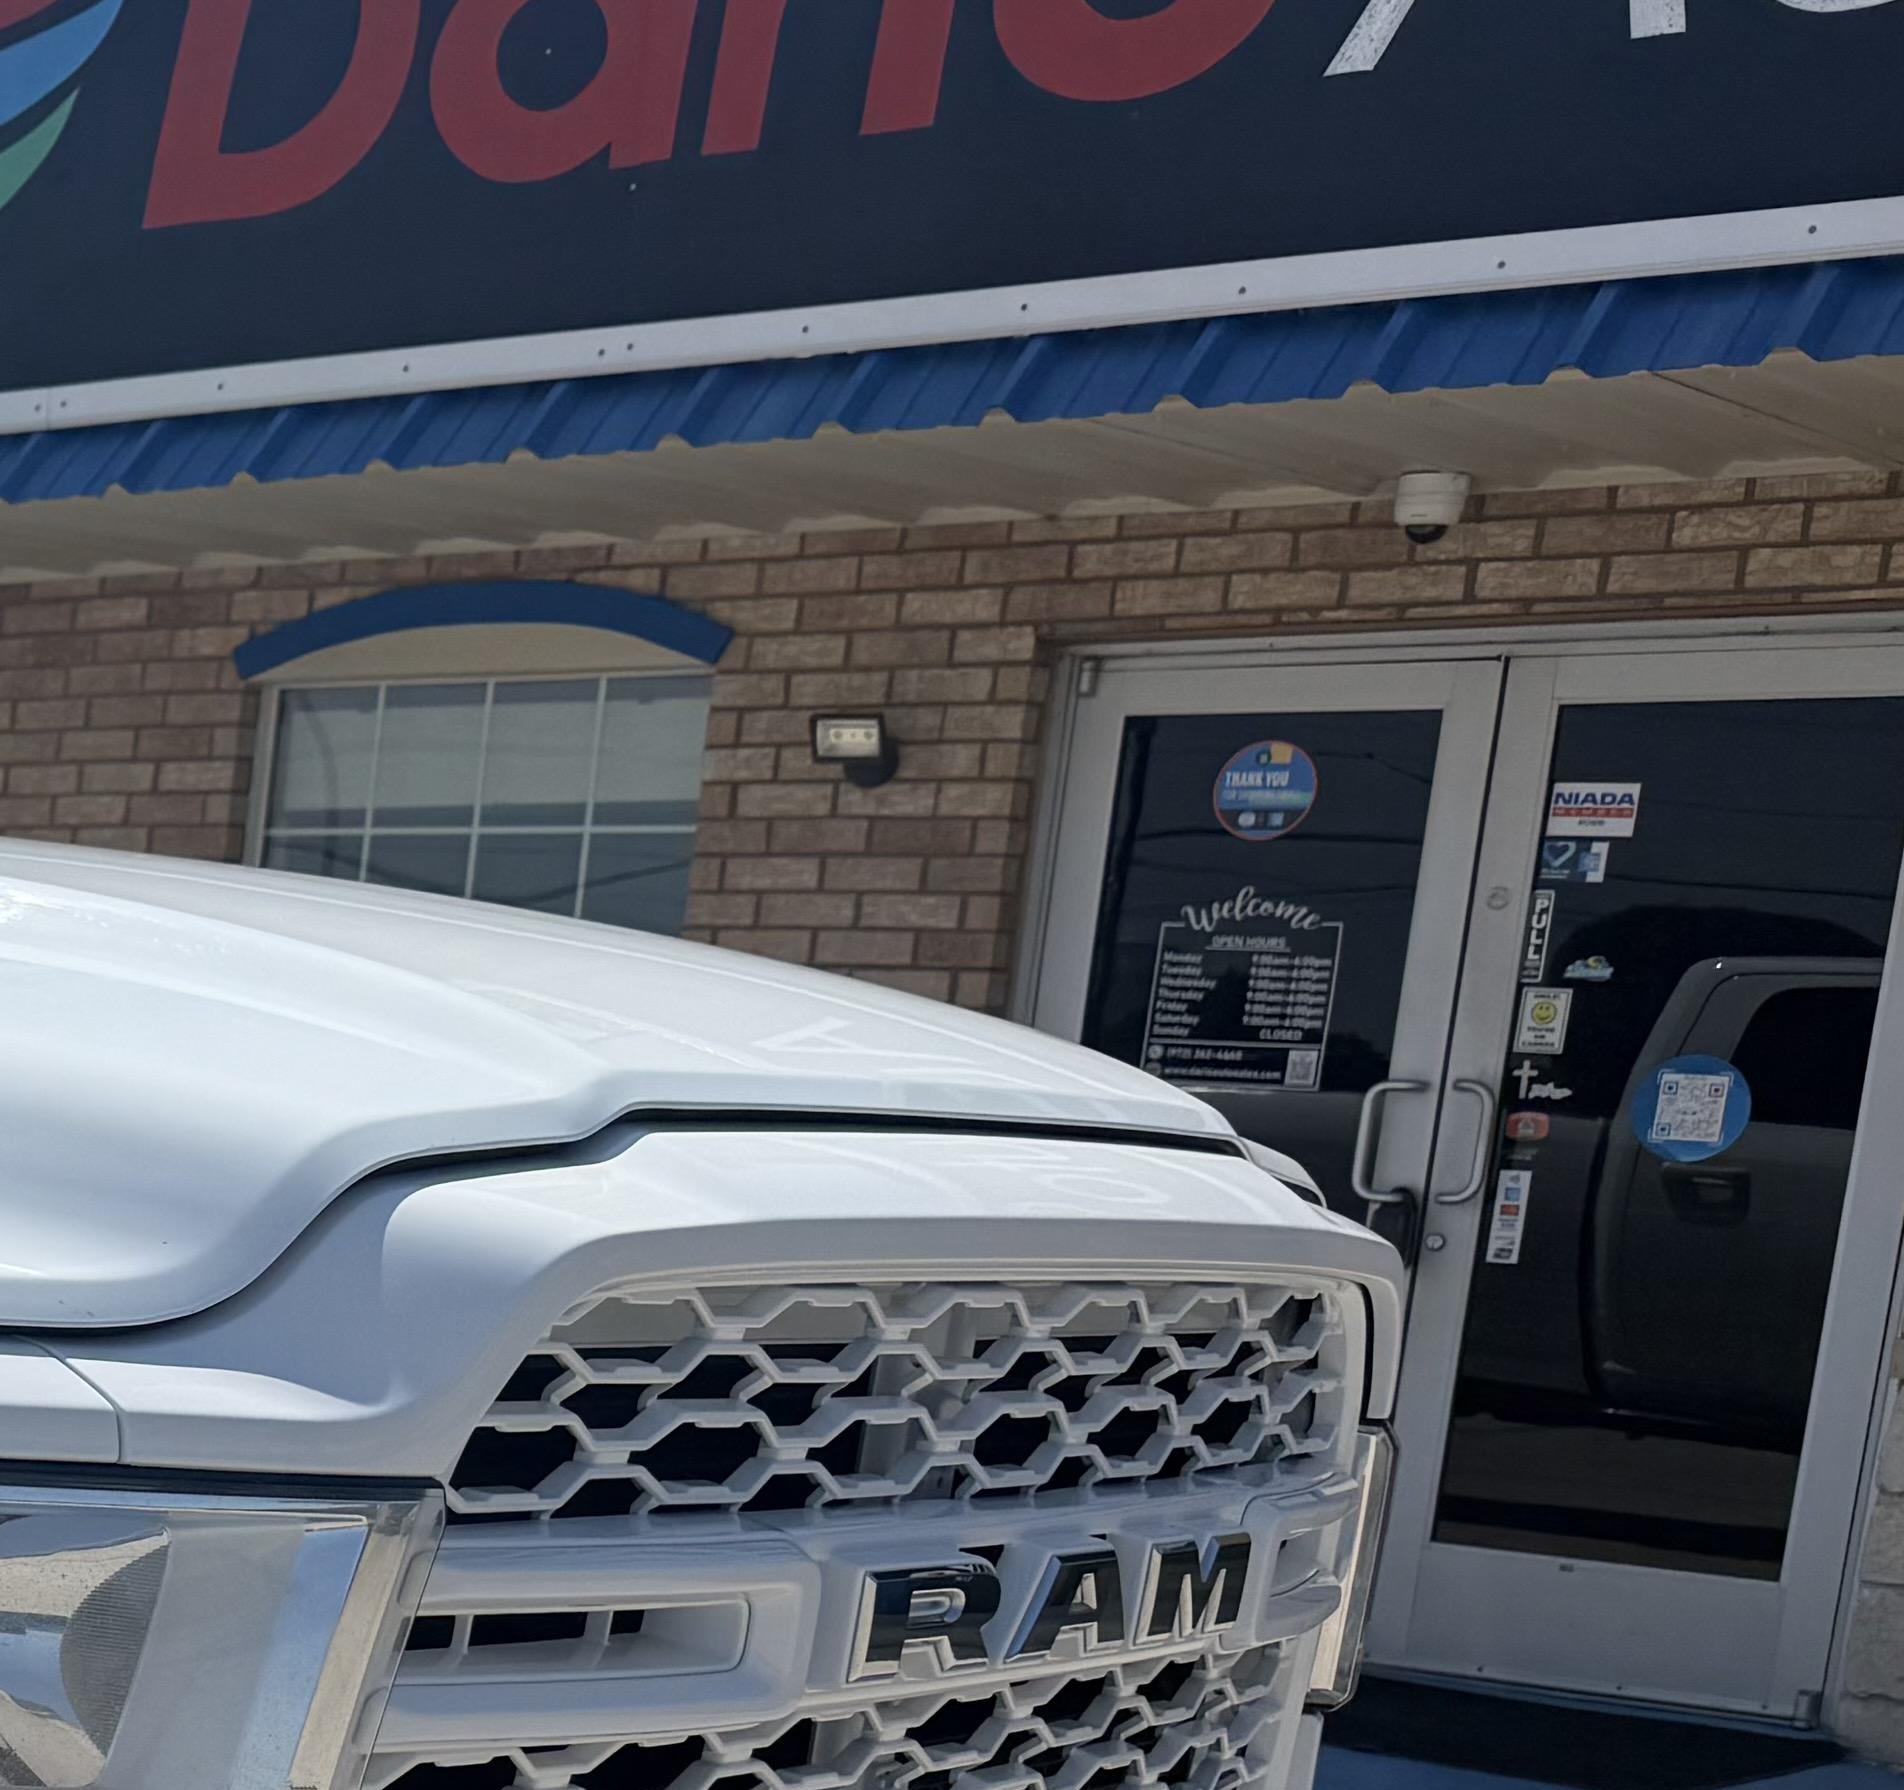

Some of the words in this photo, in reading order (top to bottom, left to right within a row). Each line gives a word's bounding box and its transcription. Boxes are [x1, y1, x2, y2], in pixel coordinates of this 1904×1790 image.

[1267, 771, 1289, 787] YOU
[1553, 792, 1635, 806] NIADA
[1181, 885, 1321, 932] Welcome
[1527, 898, 1549, 960] PULL
[1212, 935, 1242, 947] OPEN
[1246, 936, 1287, 948] HOURS
[1163, 951, 1202, 964] Monday
[1162, 964, 1202, 976] Tuesday
[1160, 976, 1216, 989] Wednesday
[1158, 988, 1204, 1001] Thursday
[1156, 1001, 1188, 1013] Friday
[1154, 1013, 1200, 1026] Saturday
[1152, 1024, 1190, 1037] Sunday
[1259, 1029, 1303, 1040] CLOSED
[847, 1532, 1252, 1683] RAM
